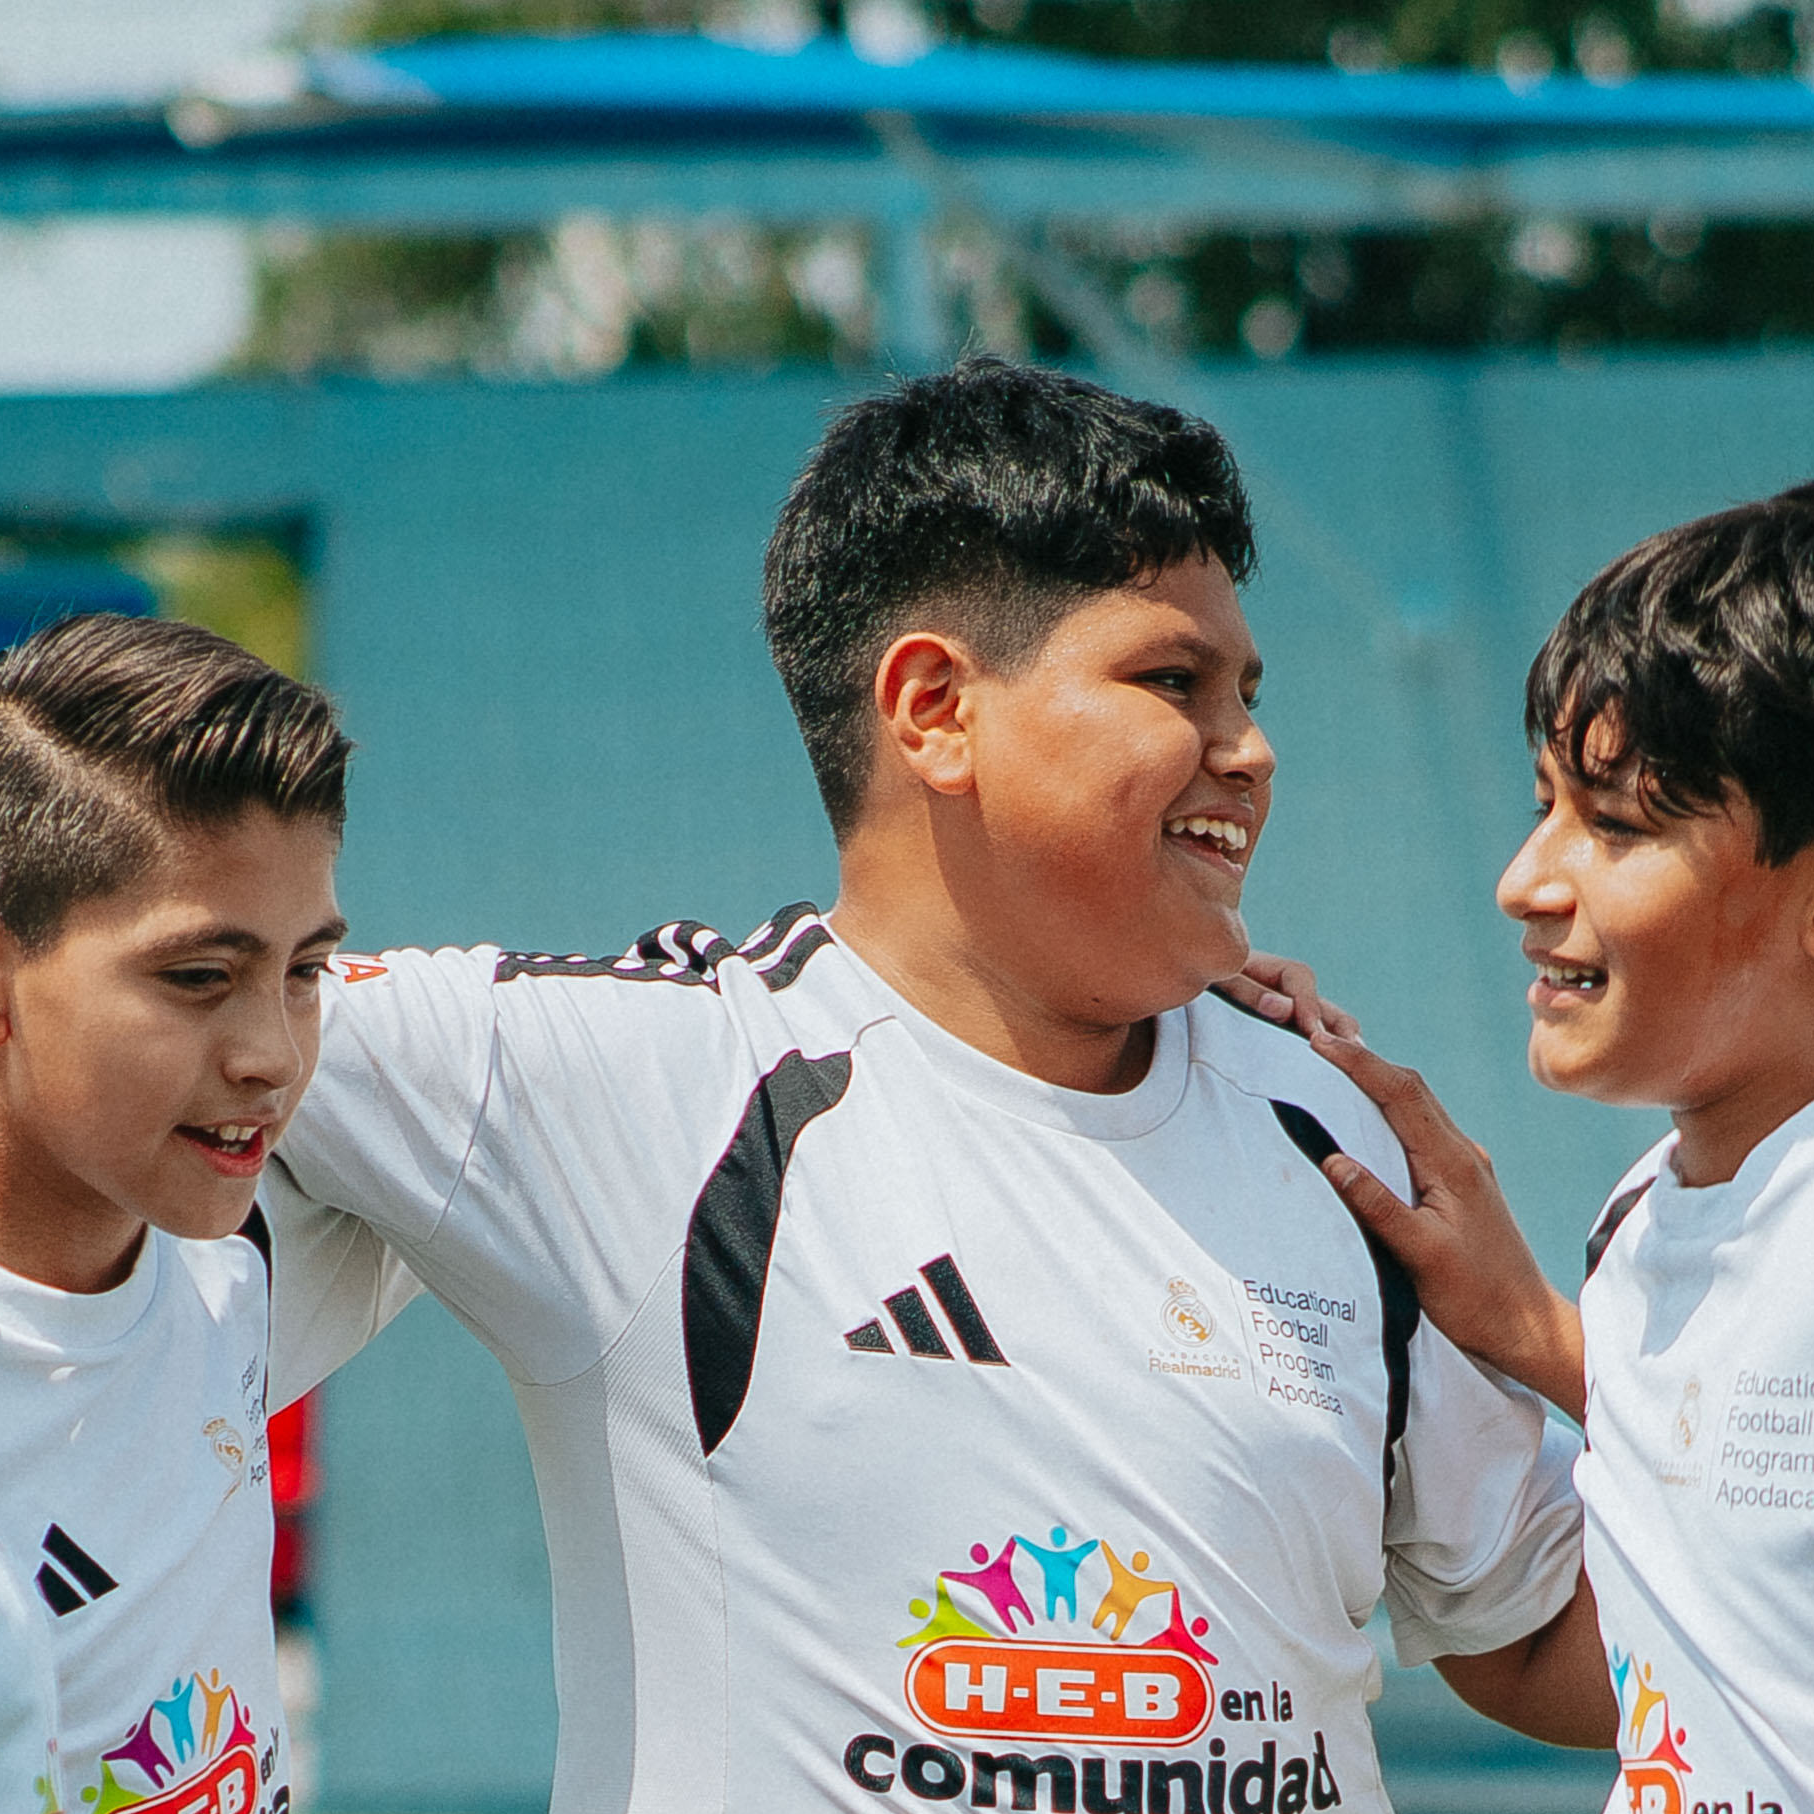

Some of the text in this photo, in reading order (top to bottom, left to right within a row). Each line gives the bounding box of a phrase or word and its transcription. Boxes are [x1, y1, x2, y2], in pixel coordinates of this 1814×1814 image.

[1243, 1279, 1357, 1323] Educational
[1250, 1310, 1329, 1348] Football
[1258, 1342, 1337, 1383] Program
[1268, 1376, 1344, 1416] Apodaca
[1727, 1405, 1814, 1436] Football
[943, 1661, 1294, 1723] H-E-B en la
